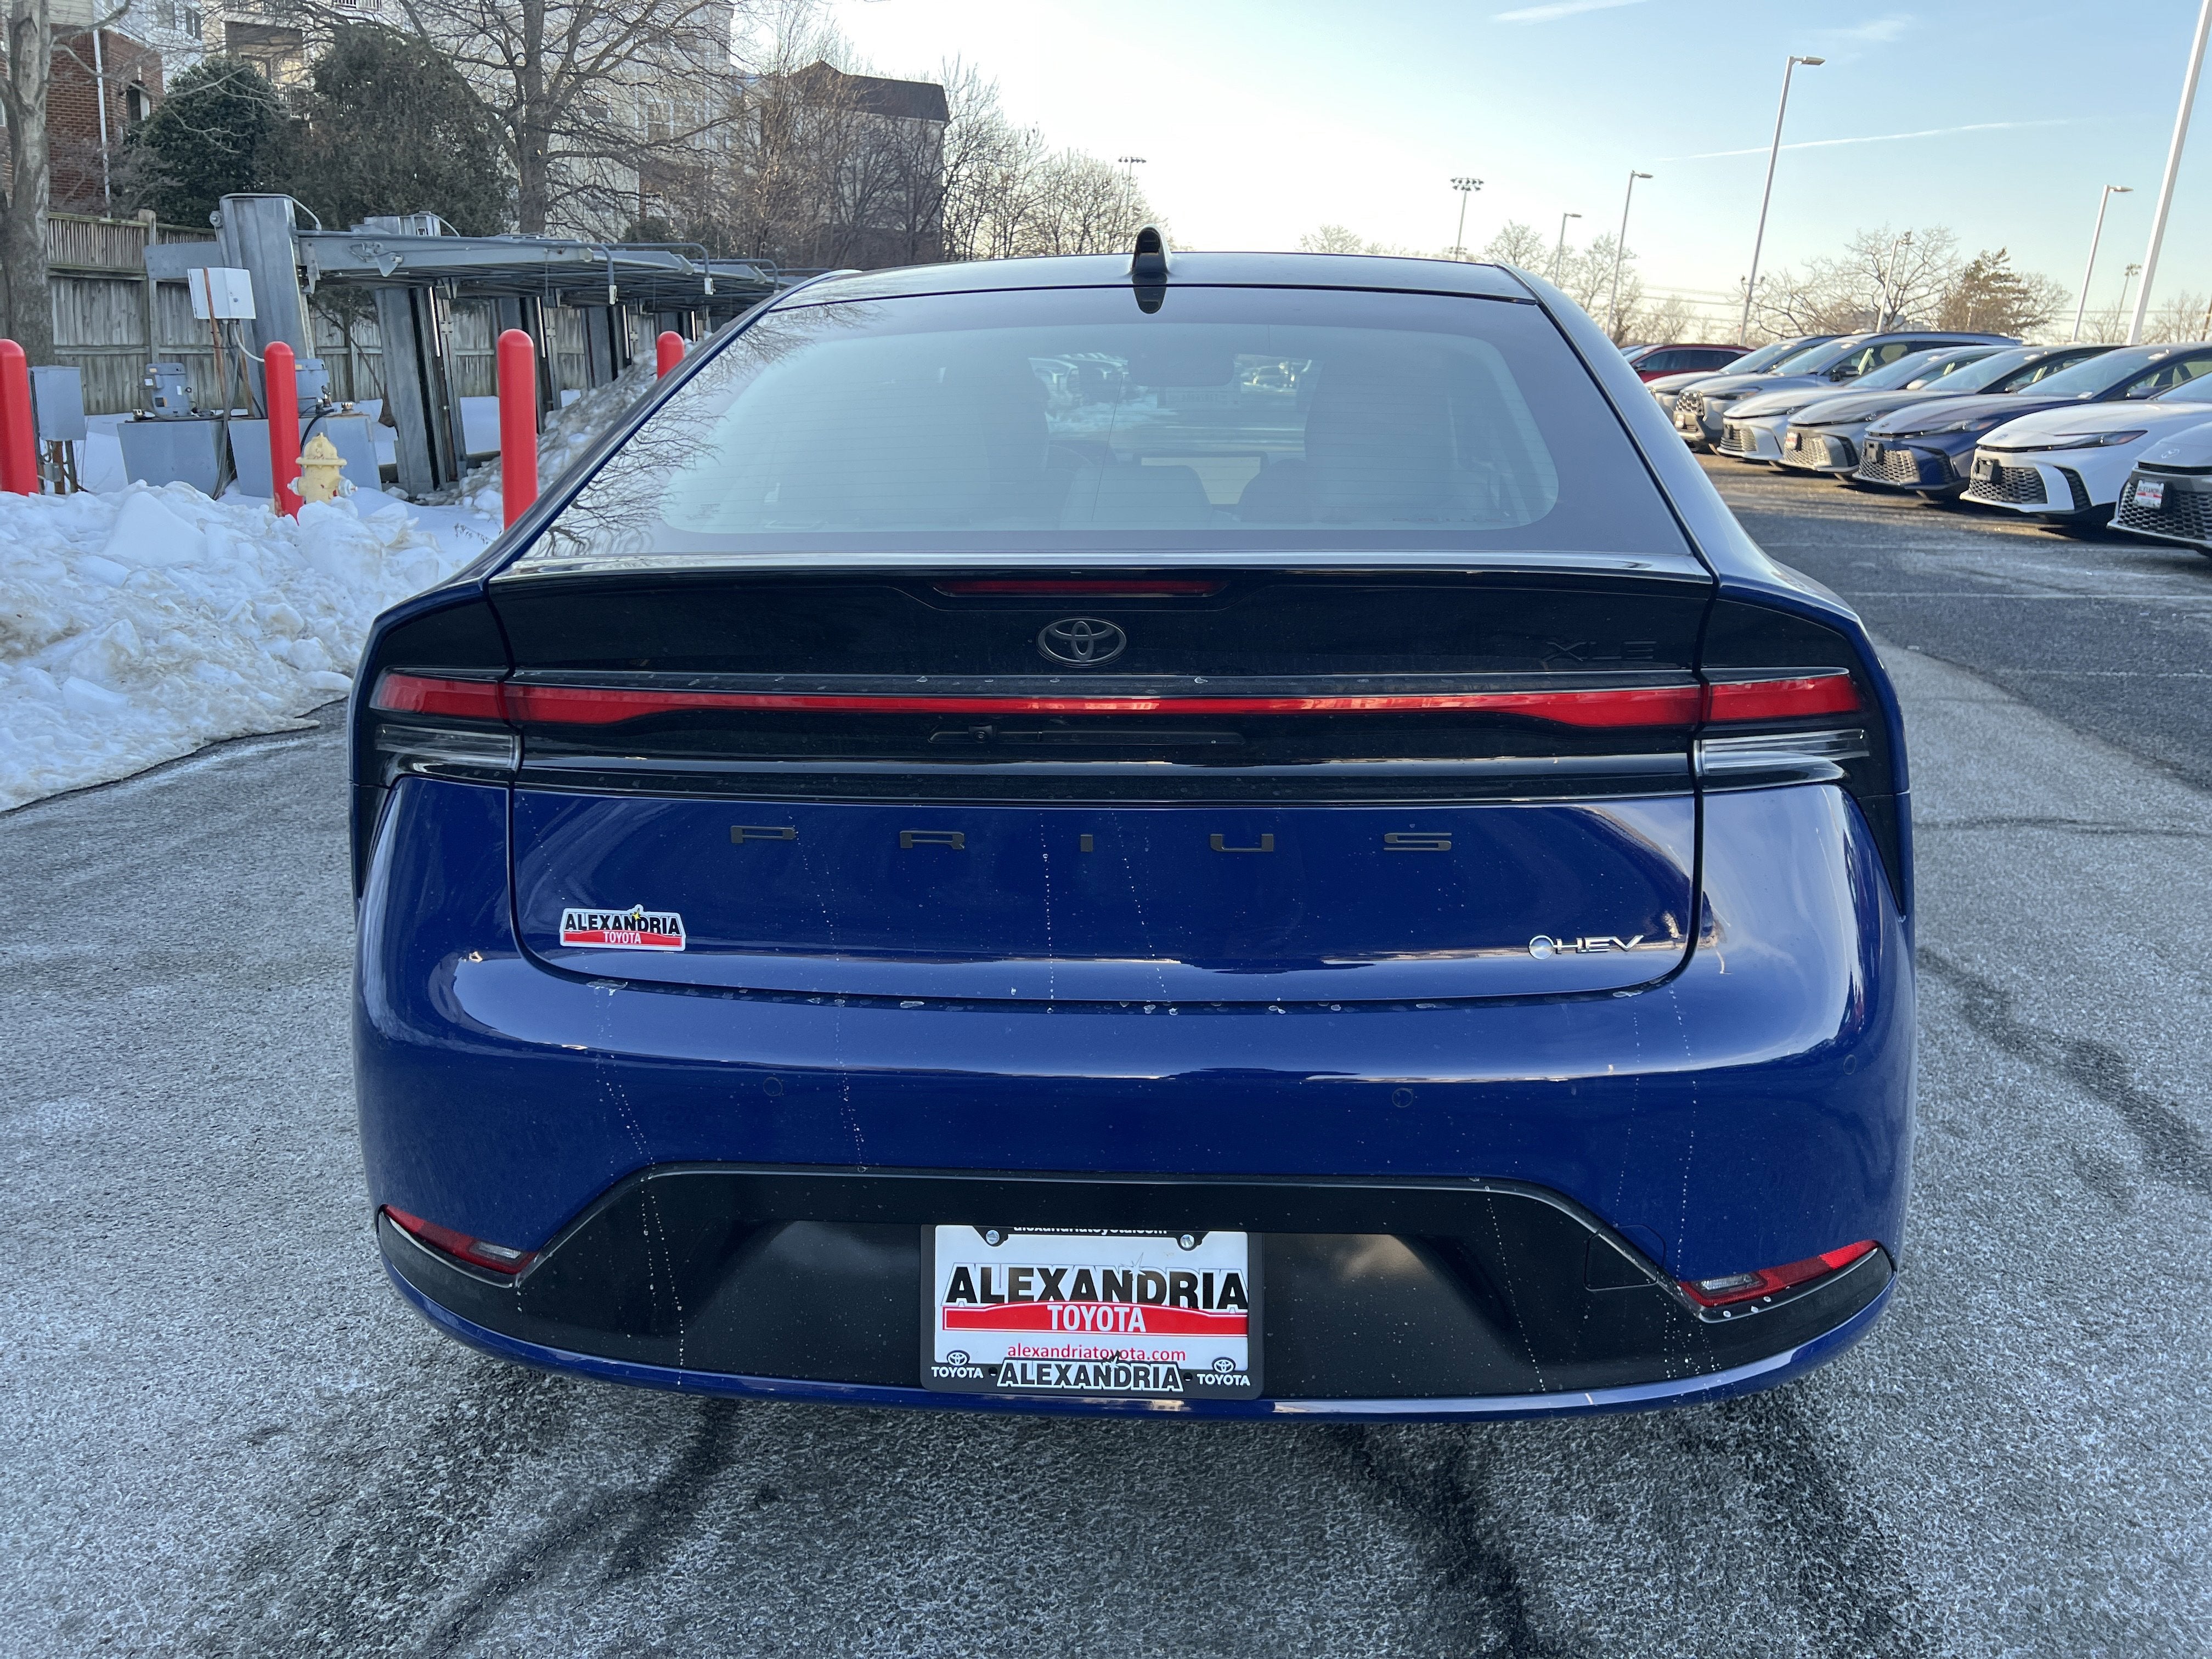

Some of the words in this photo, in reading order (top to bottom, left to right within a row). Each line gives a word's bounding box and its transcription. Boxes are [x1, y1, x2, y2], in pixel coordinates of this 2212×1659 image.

[1541, 640, 1657, 662] XLE
[730, 825, 1452, 852] PRIUS
[565, 912, 680, 935] ALEXANDRIA
[603, 930, 641, 944] TOYOTA
[945, 1266, 1248, 1310] ALEXANDRIA
[1047, 1304, 1147, 1333] TOYOTA
[931, 1366, 984, 1379] TOYOTA
[999, 1361, 1182, 1390] ALEXANDRIA
[1197, 1373, 1251, 1386] TOYOTA
